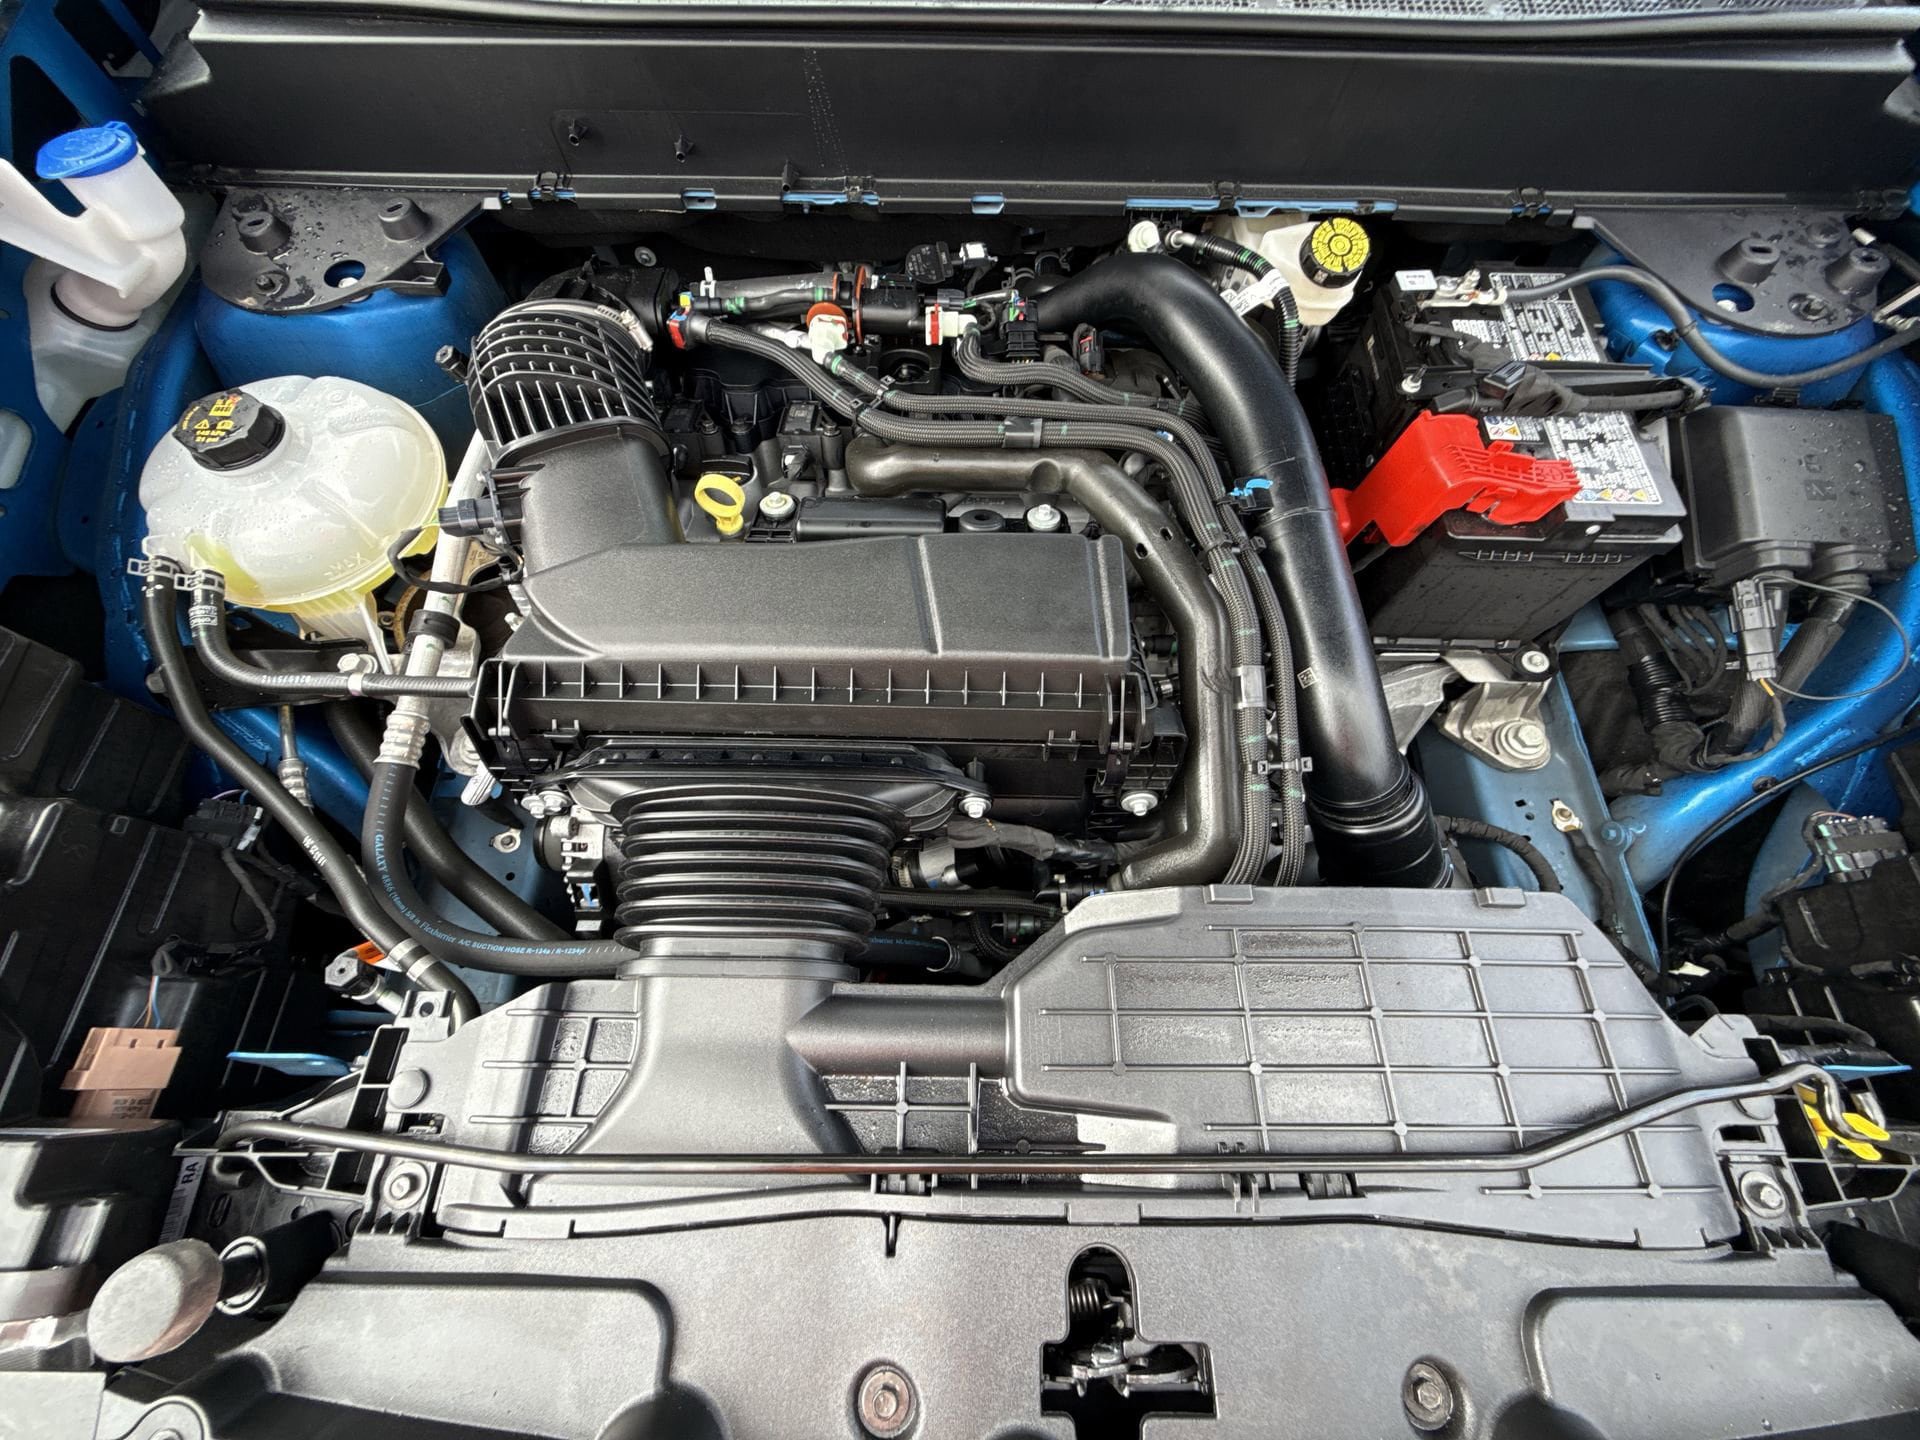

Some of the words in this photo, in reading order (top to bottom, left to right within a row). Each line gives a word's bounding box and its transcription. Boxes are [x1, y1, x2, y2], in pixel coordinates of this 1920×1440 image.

[374, 833, 388, 872] GALAXY
[419, 921, 457, 943] Flexbarrier
[458, 939, 472, 949] A/C
[472, 942, 504, 953] SUCTION
[504, 946, 525, 955] HOSE
[181, 1162, 200, 1184] RA
